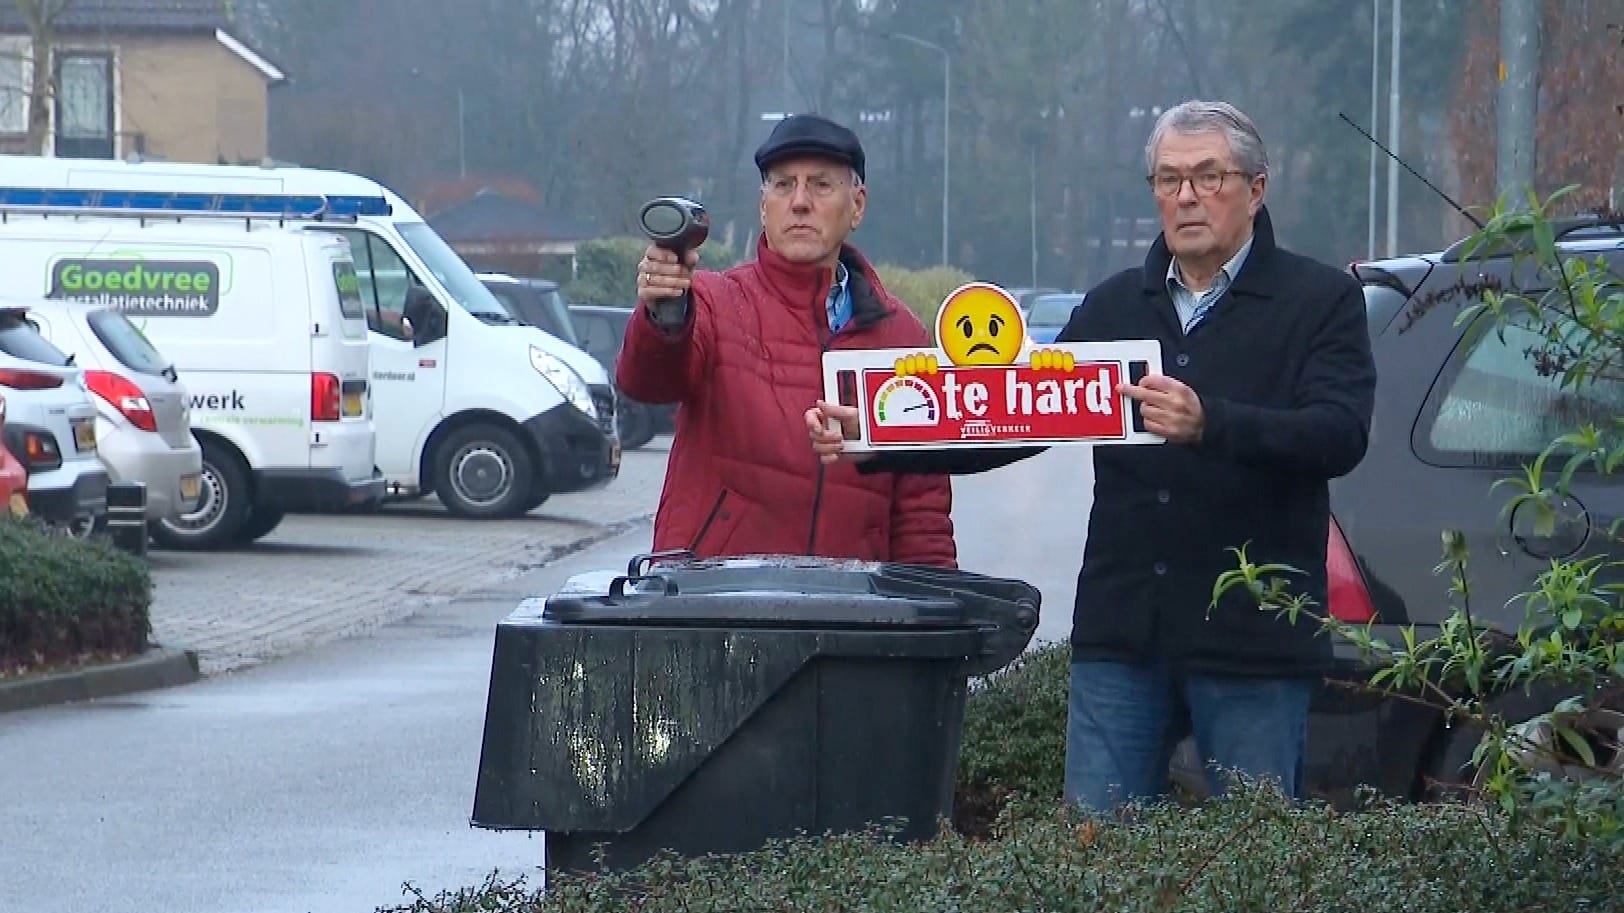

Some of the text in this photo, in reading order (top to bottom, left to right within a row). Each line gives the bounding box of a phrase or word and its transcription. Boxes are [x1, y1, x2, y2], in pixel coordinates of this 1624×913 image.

[60, 263, 211, 291] Goedvree
[63, 293, 209, 312] tallatietechniek
[189, 389, 245, 411] werk
[941, 369, 1113, 421] te hard
